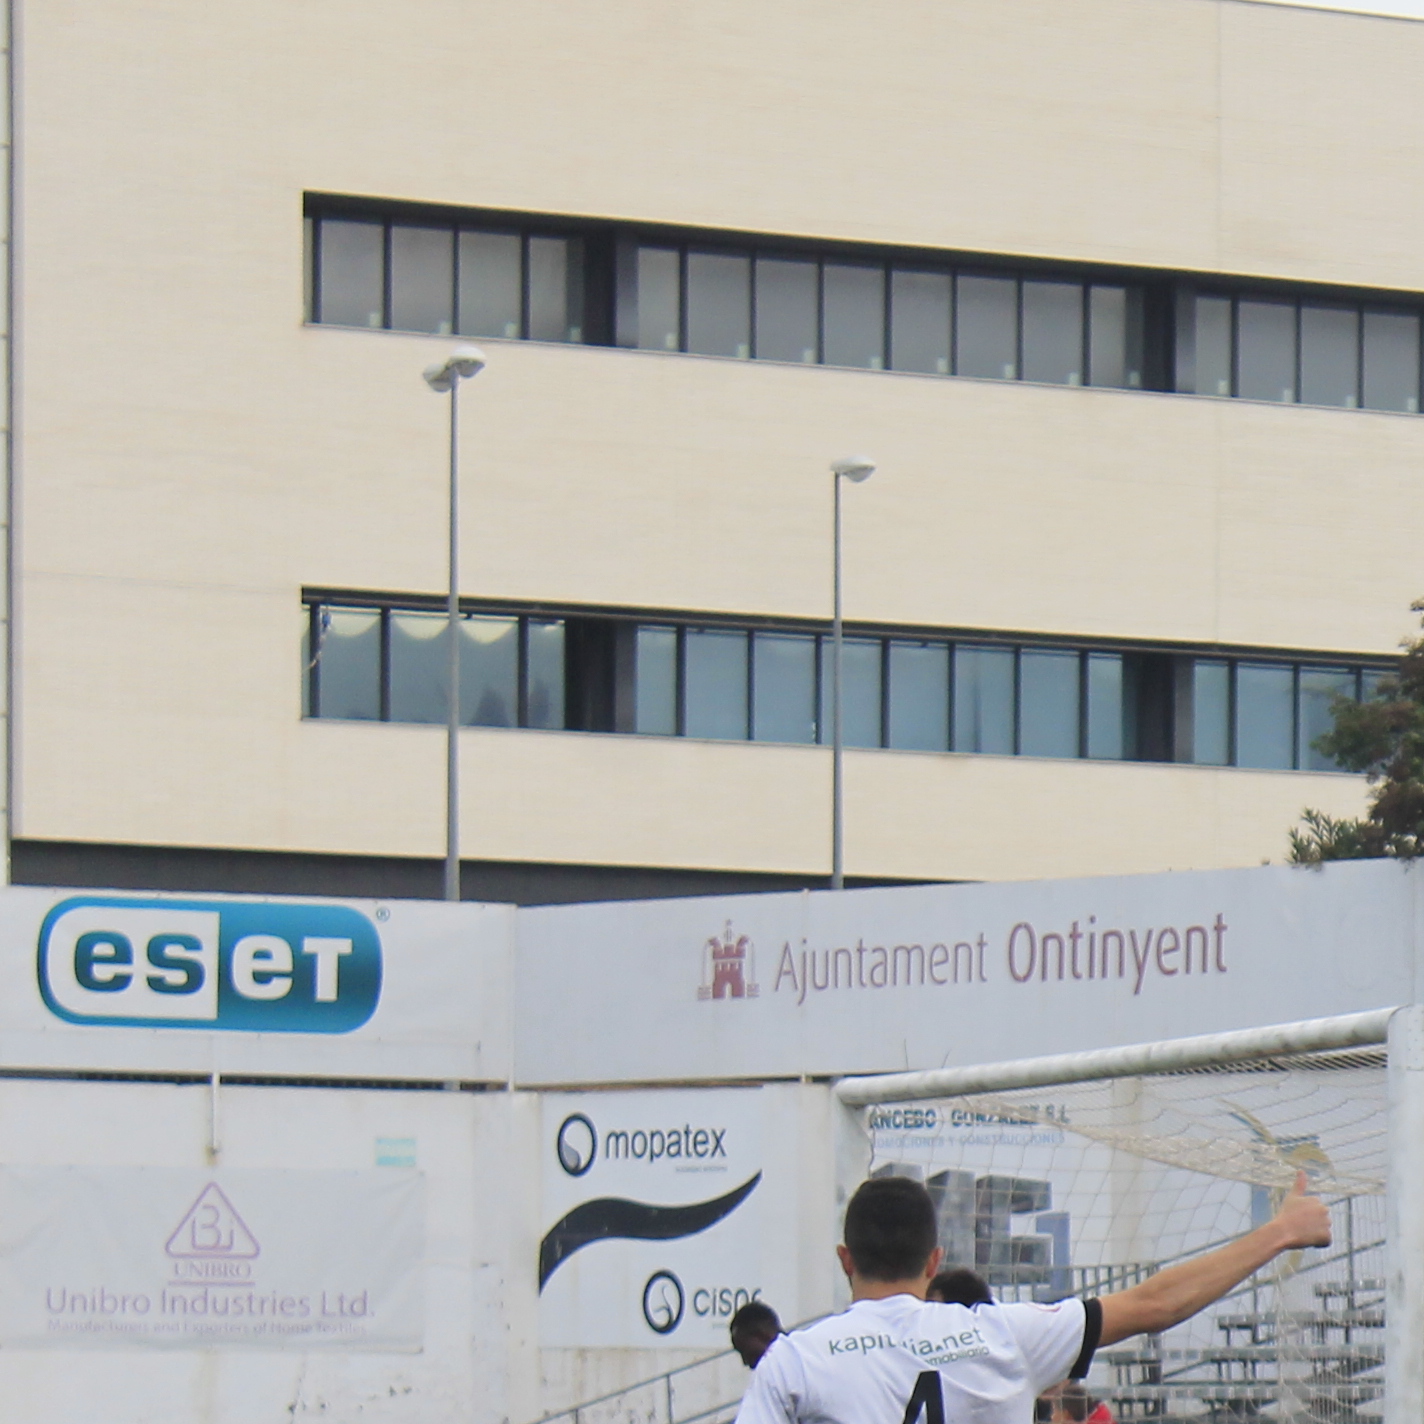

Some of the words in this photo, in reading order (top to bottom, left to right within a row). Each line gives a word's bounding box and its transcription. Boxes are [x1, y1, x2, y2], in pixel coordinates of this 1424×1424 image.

[775, 932, 988, 1006] Ajuntament
[1008, 913, 1228, 995] Ontinyent
[605, 1124, 727, 1163] mopatex
[174, 1262, 252, 1279] UNIBRO
[46, 1287, 151, 1315] Unibro
[161, 1289, 311, 1317] Industries
[321, 1291, 377, 1319] Ltd.
